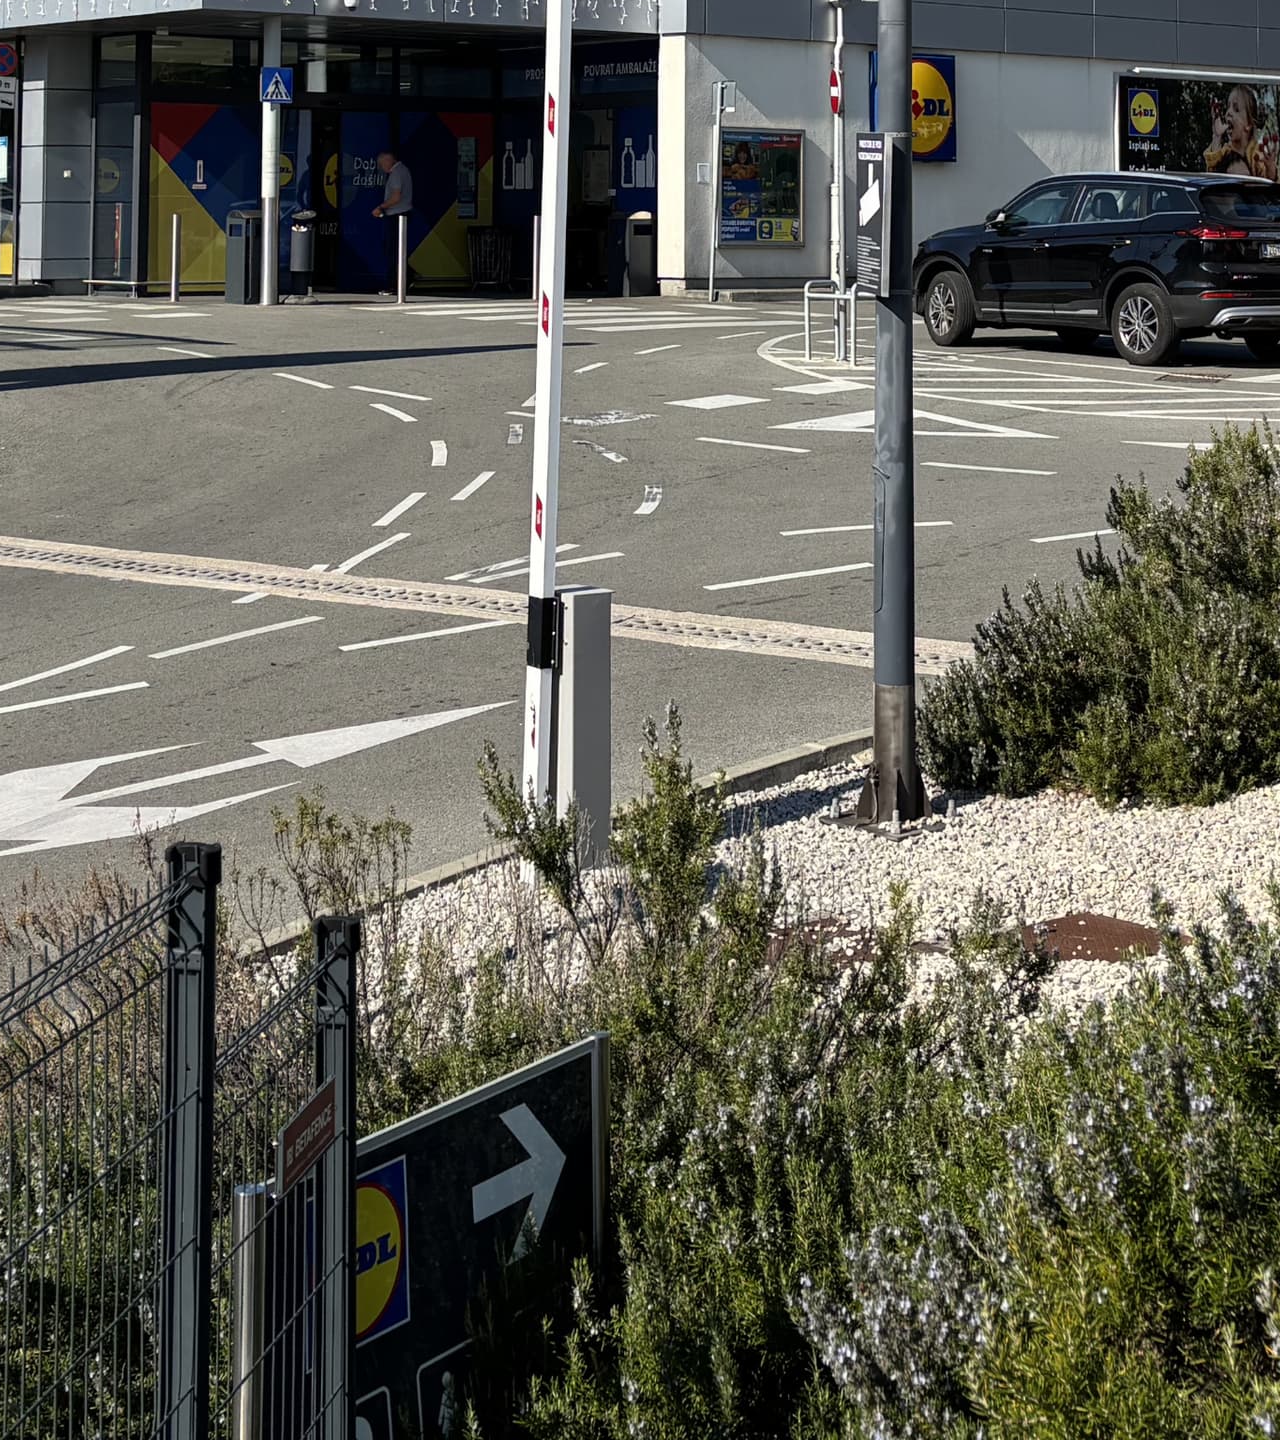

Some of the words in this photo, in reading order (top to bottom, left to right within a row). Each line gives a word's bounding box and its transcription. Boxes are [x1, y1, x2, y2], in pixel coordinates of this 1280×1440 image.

[583, 63, 615, 77] POVRAT
[615, 59, 657, 74] AMBALAŽE
[354, 157, 376, 170] Dob
